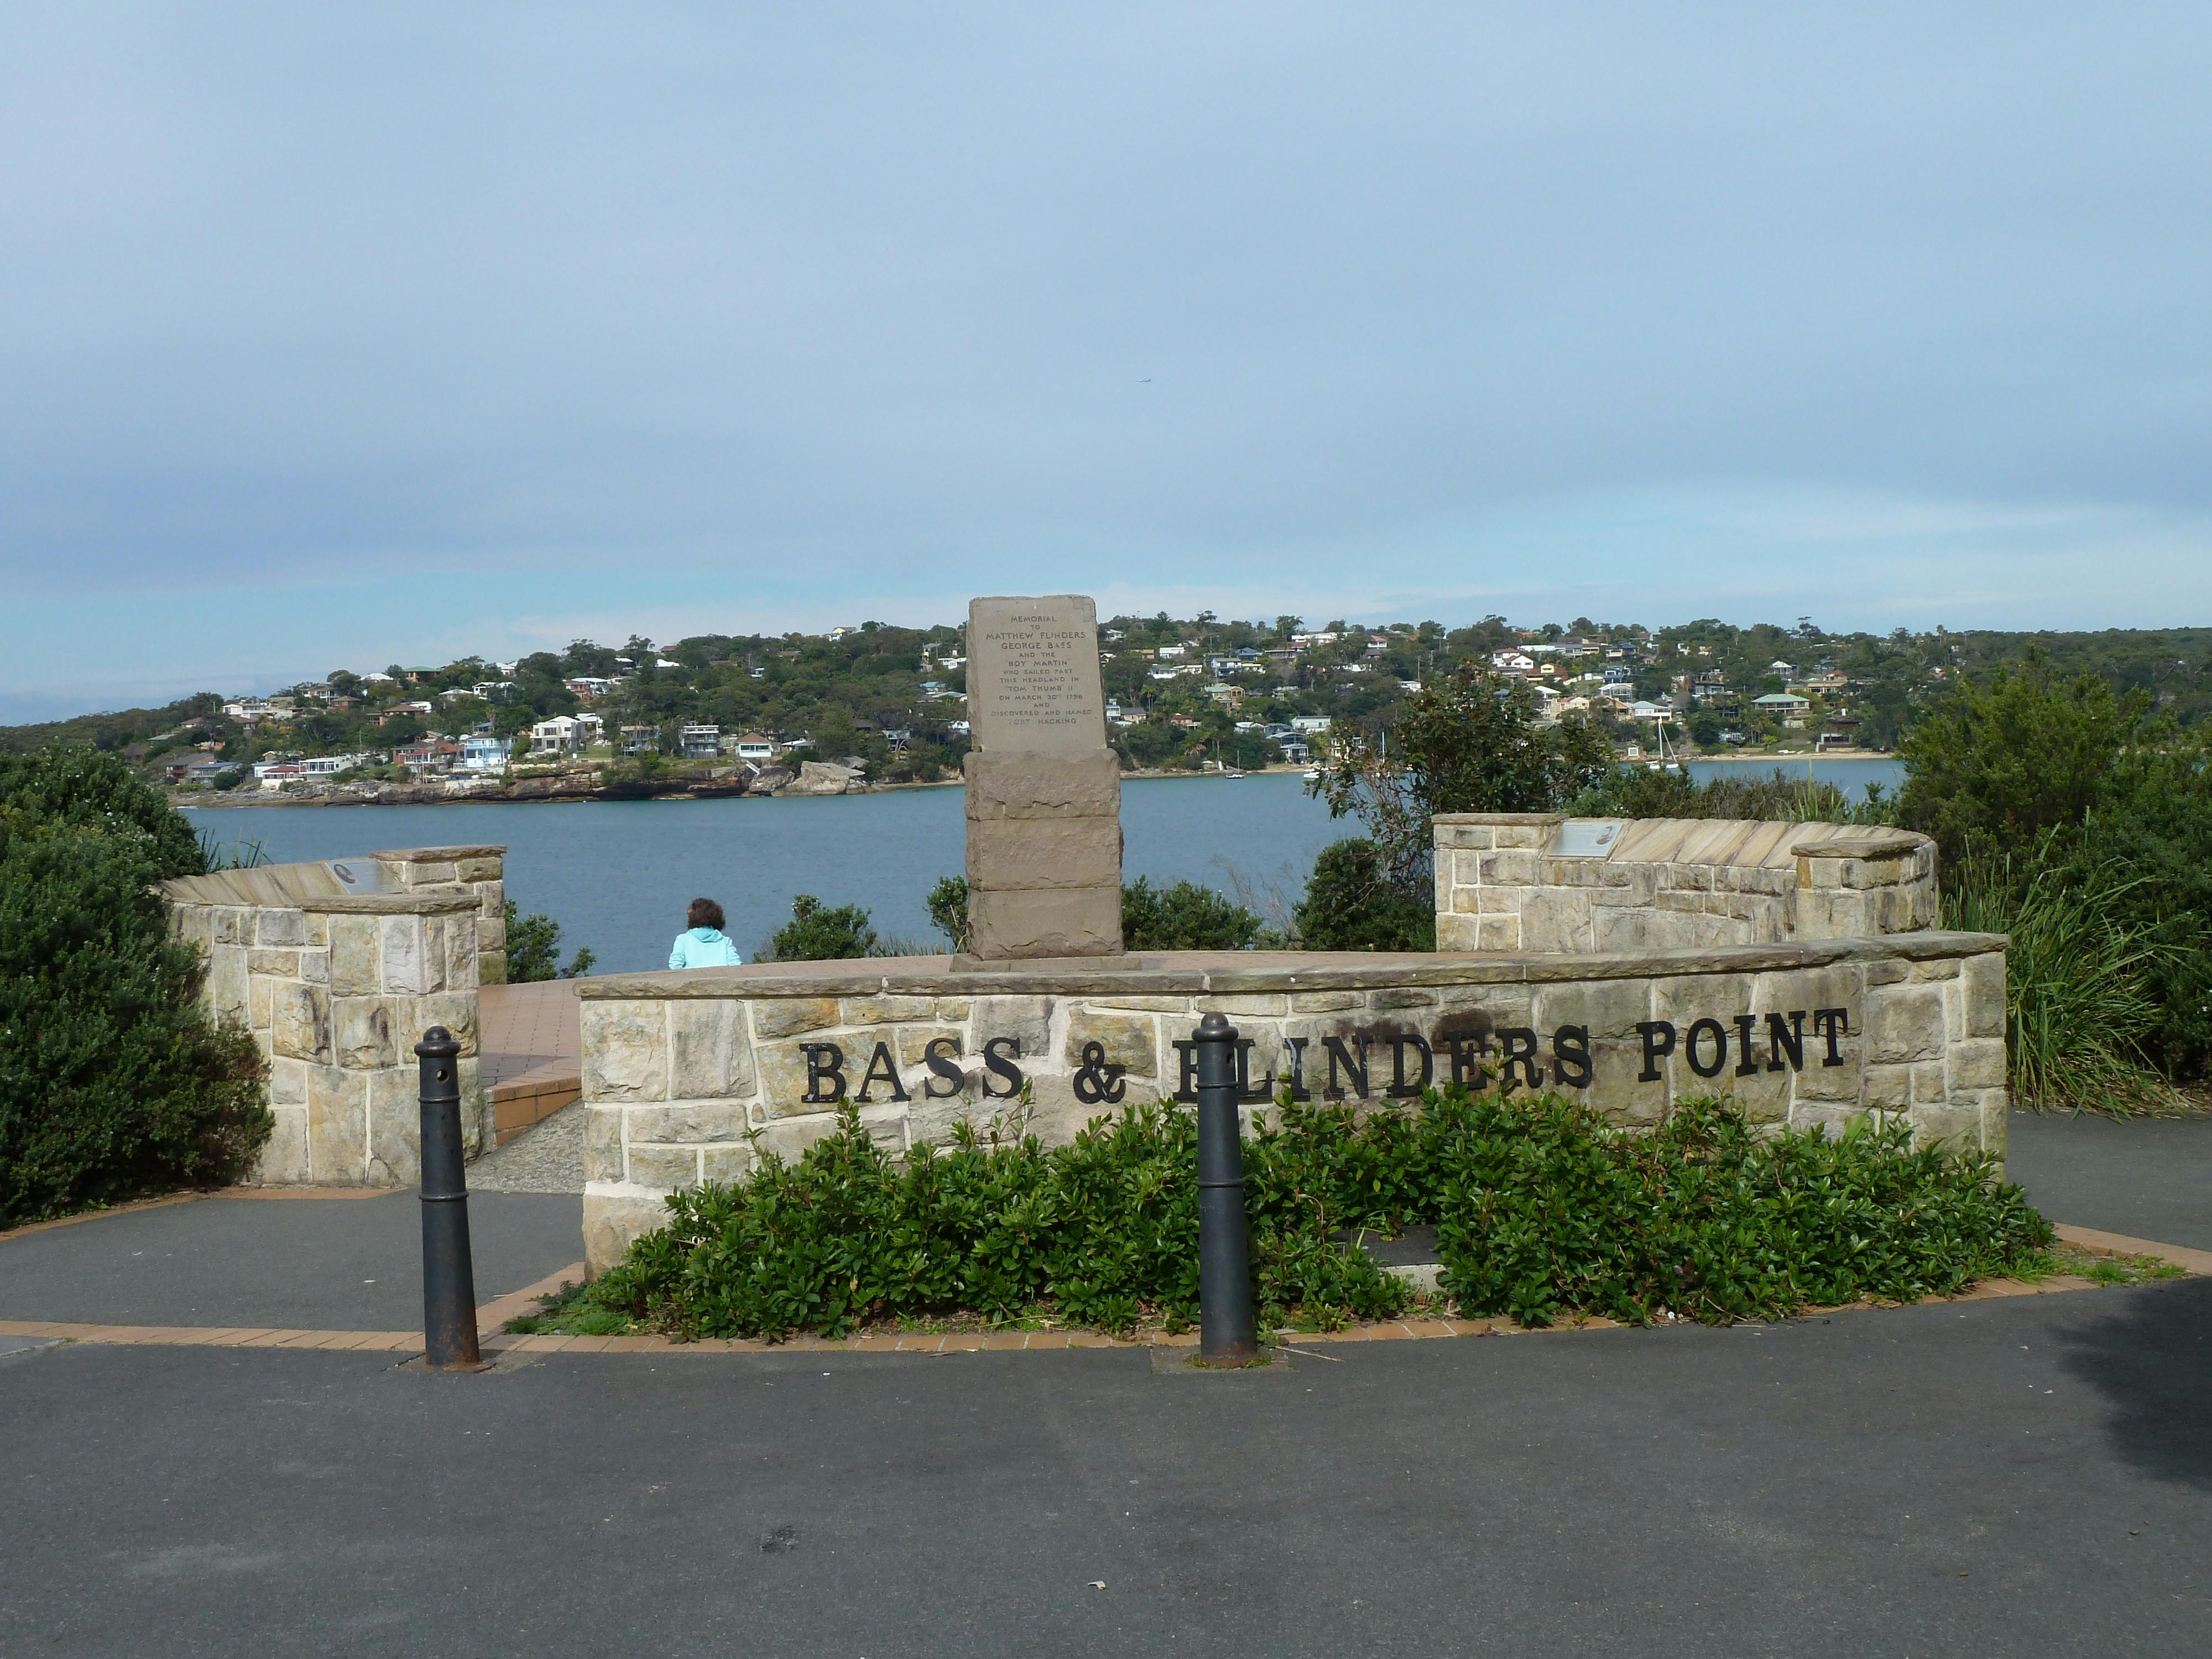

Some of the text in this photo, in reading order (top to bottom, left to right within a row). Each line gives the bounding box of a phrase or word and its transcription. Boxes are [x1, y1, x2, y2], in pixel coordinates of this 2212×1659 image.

[799, 1037, 1022, 1103] BASS
[1073, 1040, 1126, 1103] &
[1636, 1008, 1848, 1082] POINT
